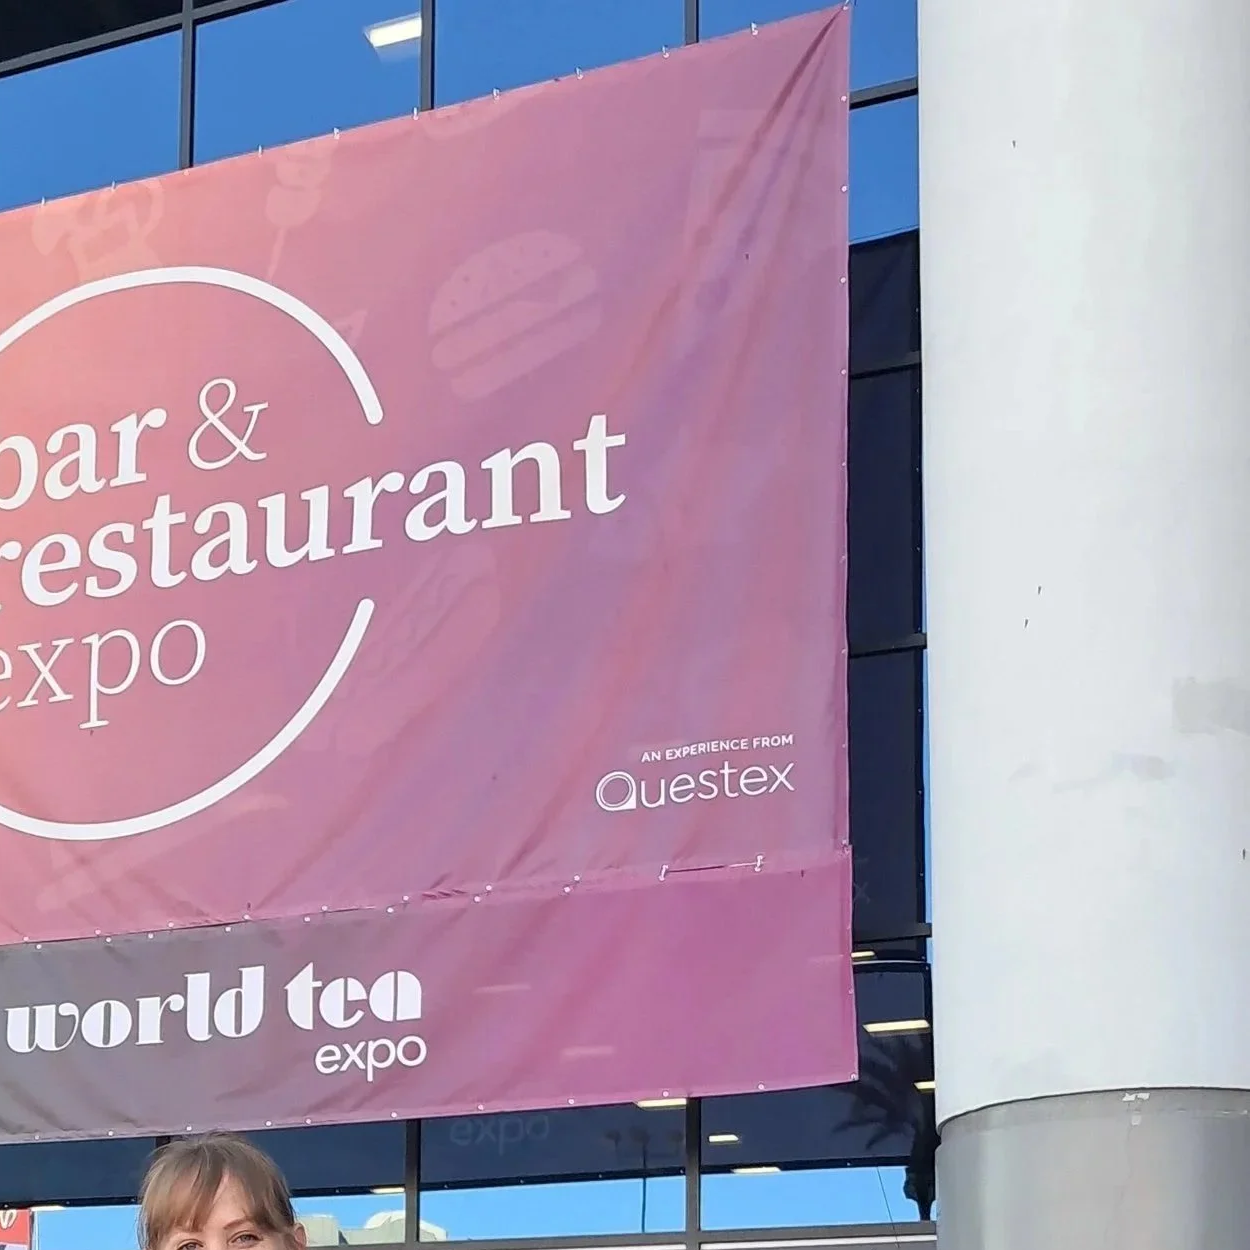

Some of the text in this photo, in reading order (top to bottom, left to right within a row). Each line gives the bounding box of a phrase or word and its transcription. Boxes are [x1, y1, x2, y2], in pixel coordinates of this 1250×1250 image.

[187, 378, 269, 470] &
[641, 734, 794, 763] AN EXPERIENCE FROM
[595, 760, 795, 812] Questex
[4, 961, 423, 1054] world tea
[314, 1035, 427, 1082] expo
